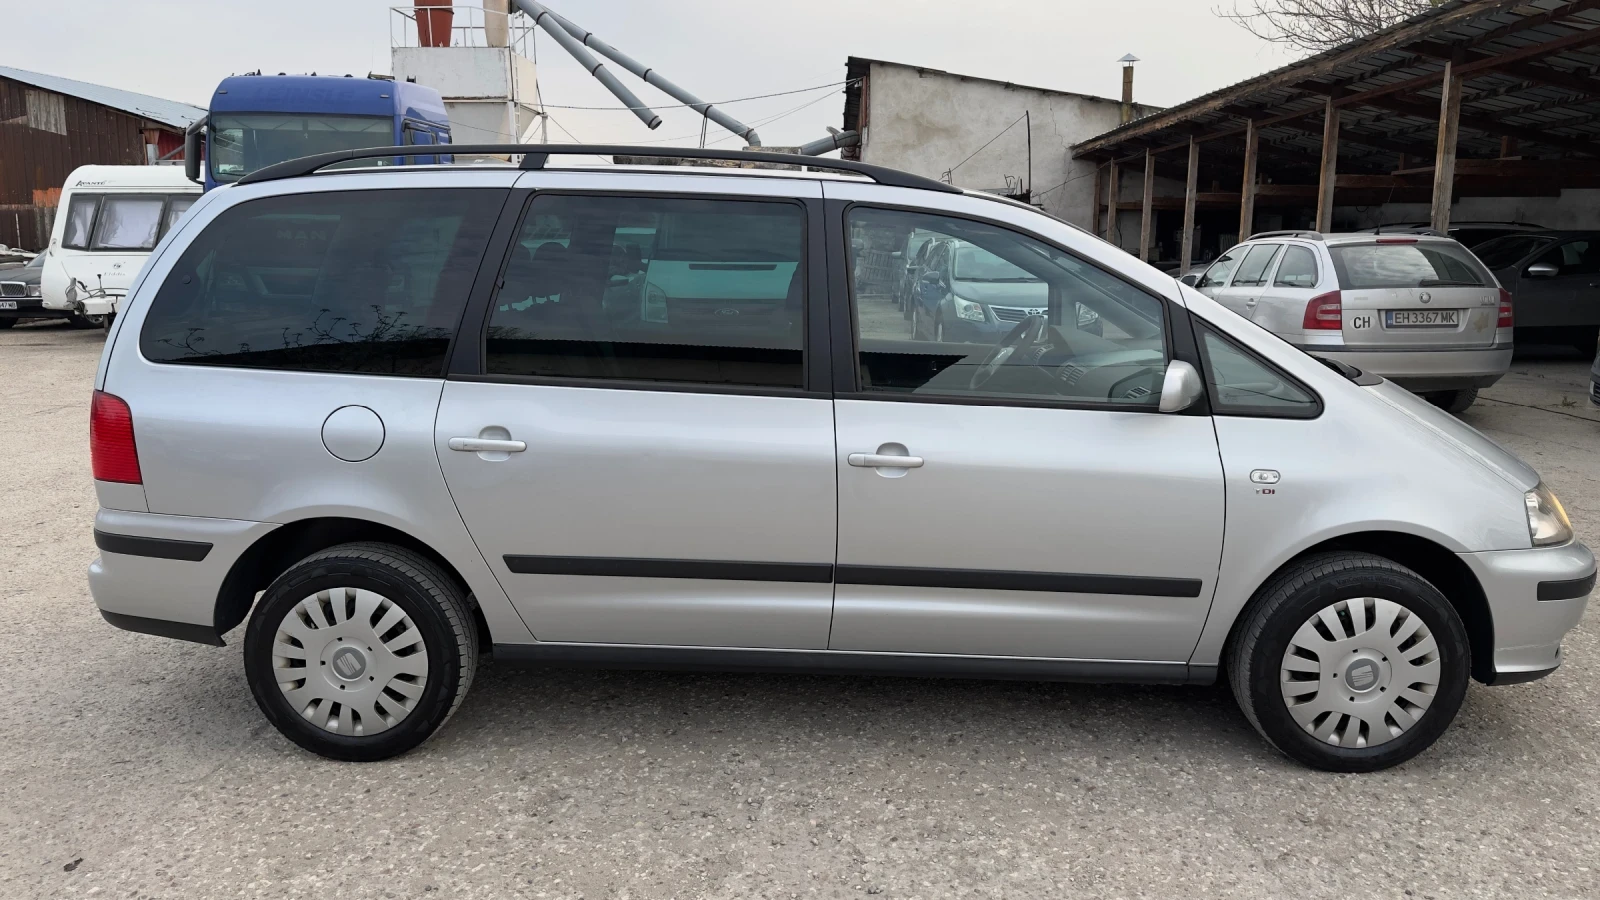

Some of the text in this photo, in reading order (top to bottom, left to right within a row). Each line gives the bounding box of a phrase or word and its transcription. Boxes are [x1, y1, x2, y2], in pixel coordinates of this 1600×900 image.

[1353, 316, 1371, 329] CH
[1395, 312, 1410, 324] EH
[1412, 312, 1439, 324] 3367
[1441, 312, 1455, 324] MK
